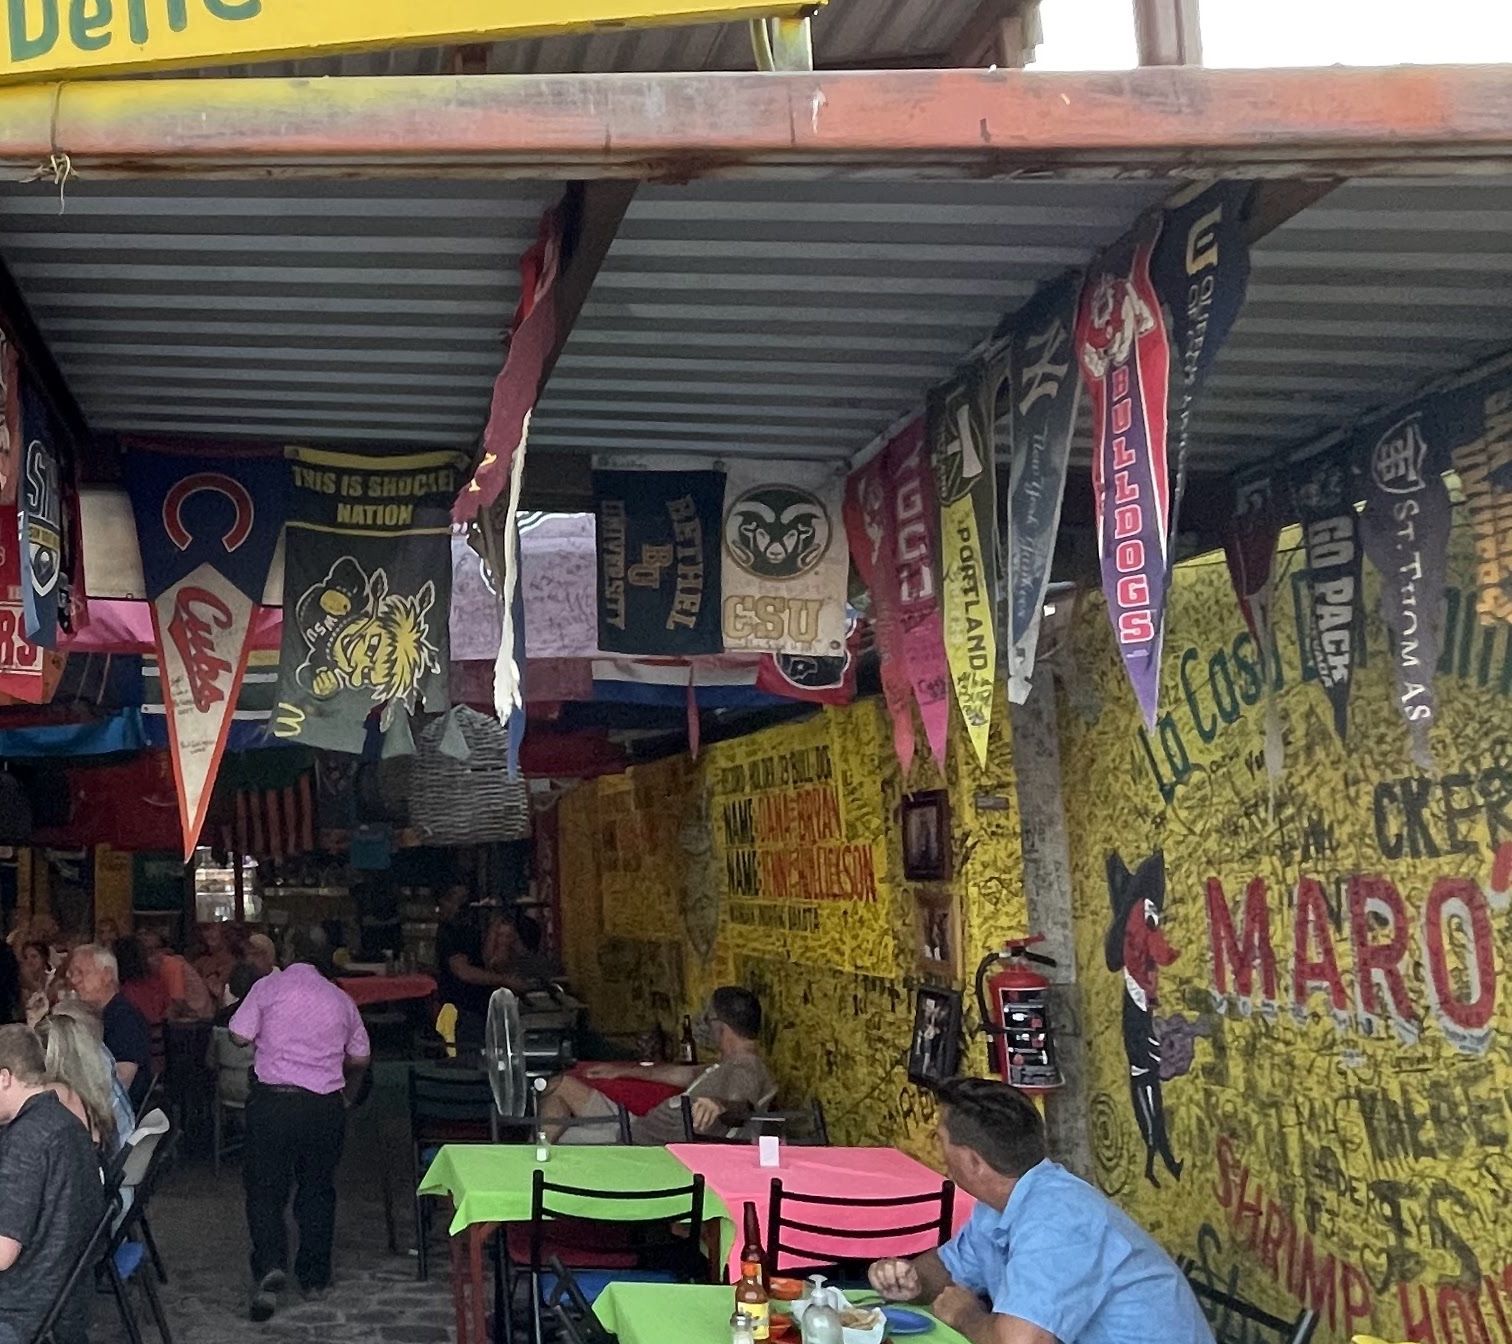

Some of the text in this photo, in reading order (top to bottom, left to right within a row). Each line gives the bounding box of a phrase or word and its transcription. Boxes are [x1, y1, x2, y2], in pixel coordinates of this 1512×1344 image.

[293, 467, 336, 494] THIS
[341, 475, 363, 497] IS
[336, 503, 414, 526] NATION
[1112, 366, 1155, 645] BULLDOGS
[665, 494, 703, 630] BETHEL
[724, 595, 825, 644] CSU
[958, 527, 989, 671] PORTLAND
[1309, 516, 1354, 685] GO PACK
[167, 587, 234, 714] Cubs
[1205, 842, 1512, 1054] MARO'
[1213, 1134, 1372, 1338] SHRIMP
